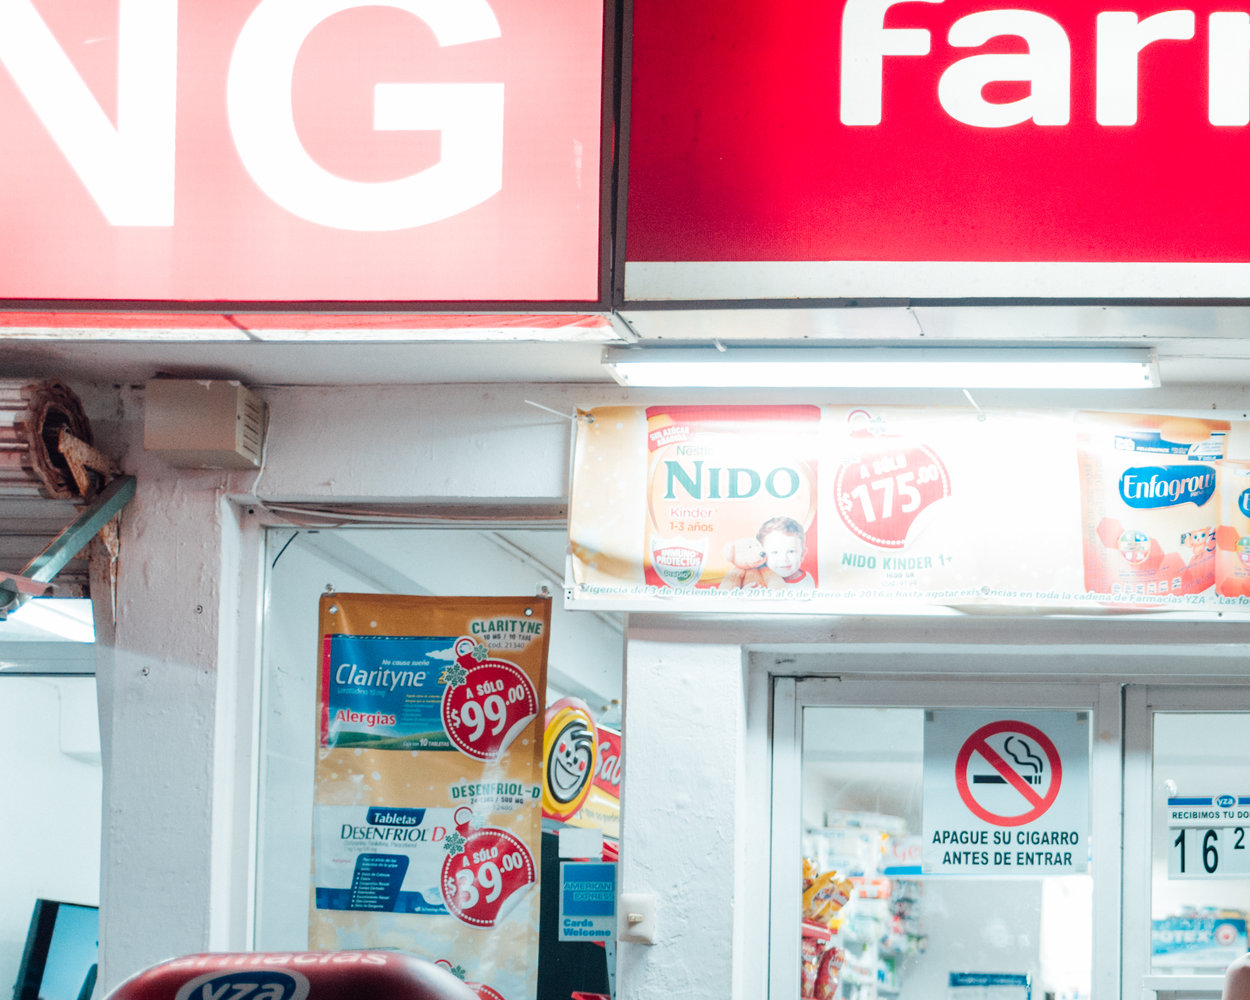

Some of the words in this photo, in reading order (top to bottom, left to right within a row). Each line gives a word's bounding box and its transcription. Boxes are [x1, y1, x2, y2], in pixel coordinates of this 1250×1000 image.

[664, 460, 800, 500] NIDO
[670, 507, 712, 518] Kinder
[670, 522, 684, 532] 1-3
[687, 522, 714, 532] años
[842, 552, 876, 570] NIDO
[883, 554, 933, 570] KINDER
[675, 587, 728, 597] Diciembre
[747, 589, 772, 597] 2015
[1035, 590, 1059, 599] toda
[1073, 591, 1111, 601] cadena
[1129, 594, 1182, 604] Farmacias
[1185, 595, 1205, 604] YZA
[1219, 596, 1236, 605] Las
[471, 619, 543, 635] CLARITYNE
[335, 663, 426, 692] Clarityne
[466, 687, 474, 699] A
[477, 679, 504, 695] SÓLO
[336, 708, 397, 728] Alergias
[450, 684, 526, 743] $99.00
[420, 738, 428, 747] 10
[1217, 796, 1234, 806] yza
[373, 812, 417, 825] Tabletas
[1172, 811, 1220, 819] RECIBIMOS
[341, 824, 427, 842] DESENFRIOL
[431, 826, 446, 842] D
[932, 831, 988, 845] APAGUE
[993, 831, 1011, 845] SU
[1016, 831, 1079, 845] CIGARRO
[462, 855, 470, 867] A
[473, 846, 499, 863] SÓLO
[942, 851, 989, 865] ANTES
[994, 851, 1011, 865] DE
[1017, 852, 1072, 866] ENTRAR
[446, 852, 523, 910] $39.00
[564, 882, 612, 890] AMERICAN
[563, 919, 594, 928] Cards
[563, 928, 611, 937] Welcome
